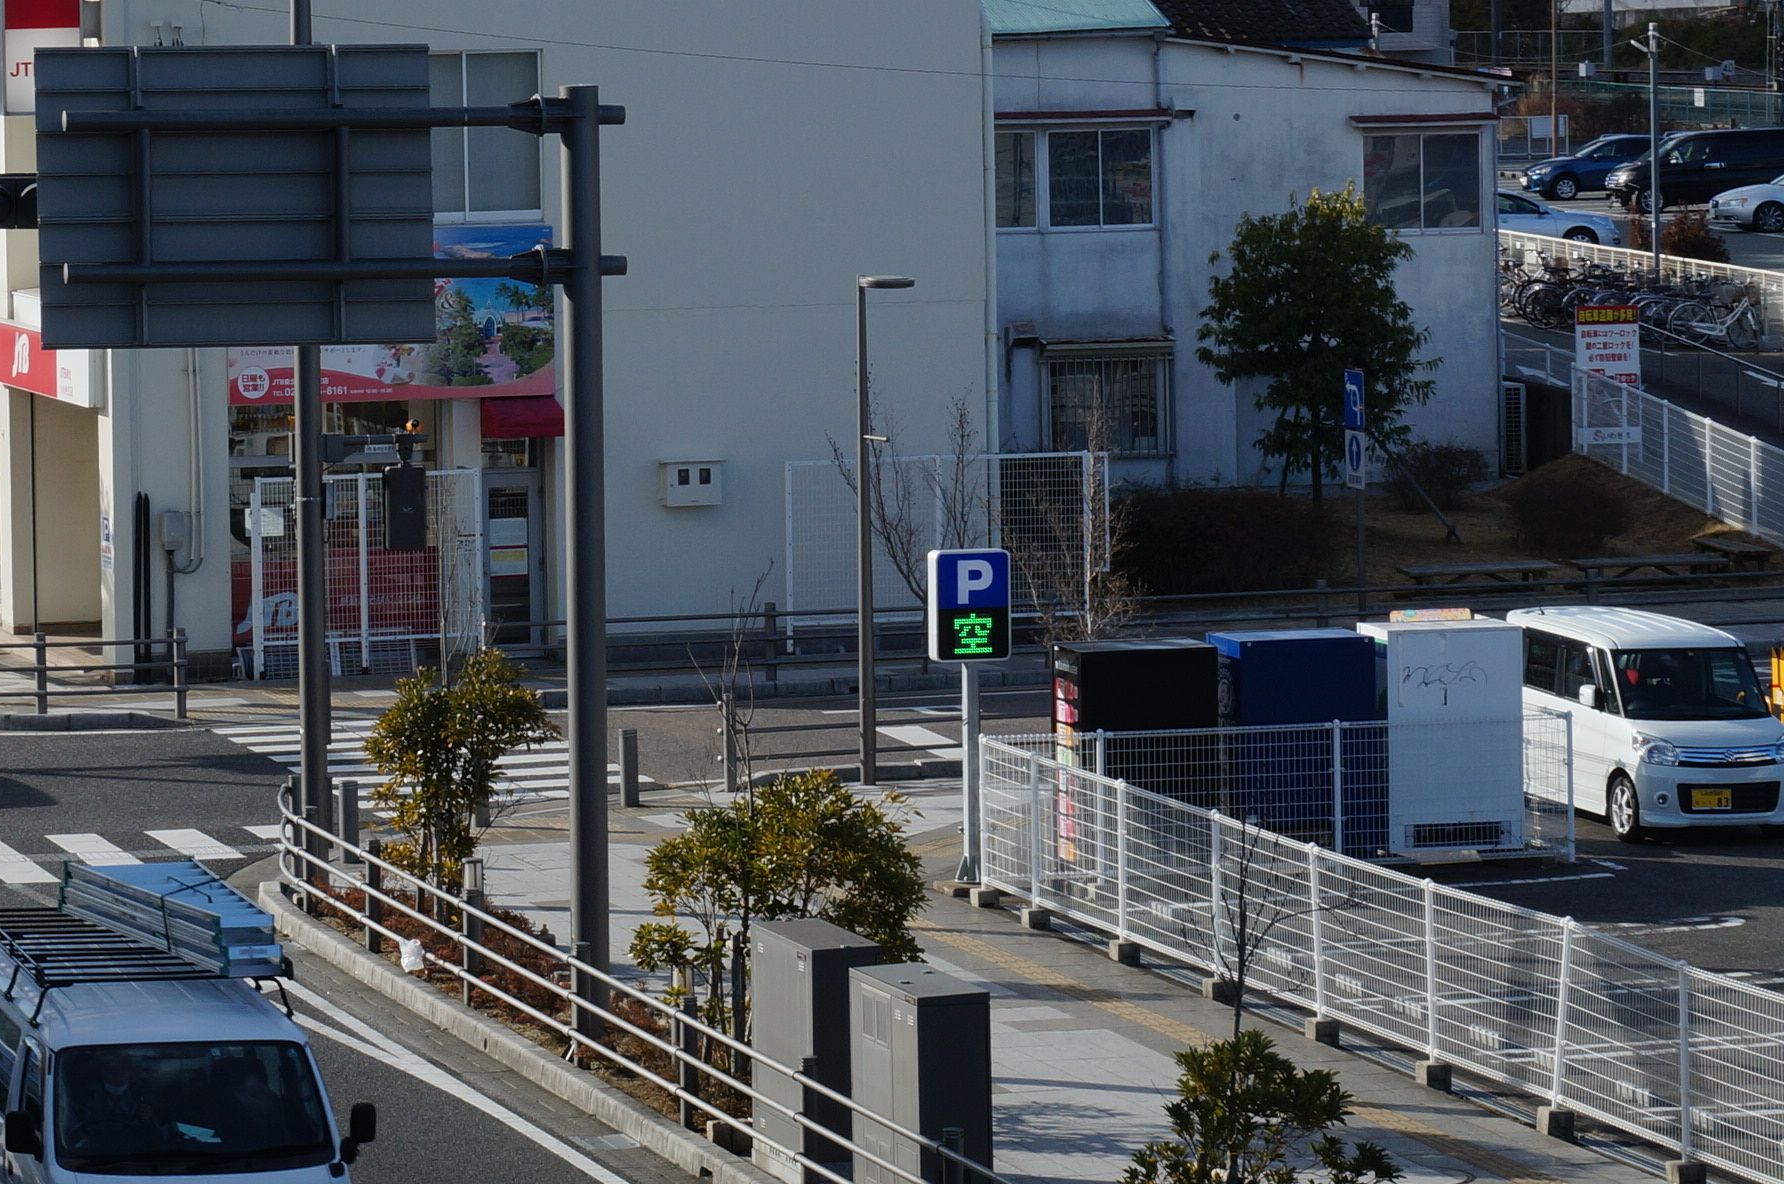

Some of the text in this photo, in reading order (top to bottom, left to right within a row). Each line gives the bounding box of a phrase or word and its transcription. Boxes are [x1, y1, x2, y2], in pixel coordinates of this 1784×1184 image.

[12, 331, 30, 378] JTB
[957, 559, 994, 605] P
[954, 613, 993, 654] 空
